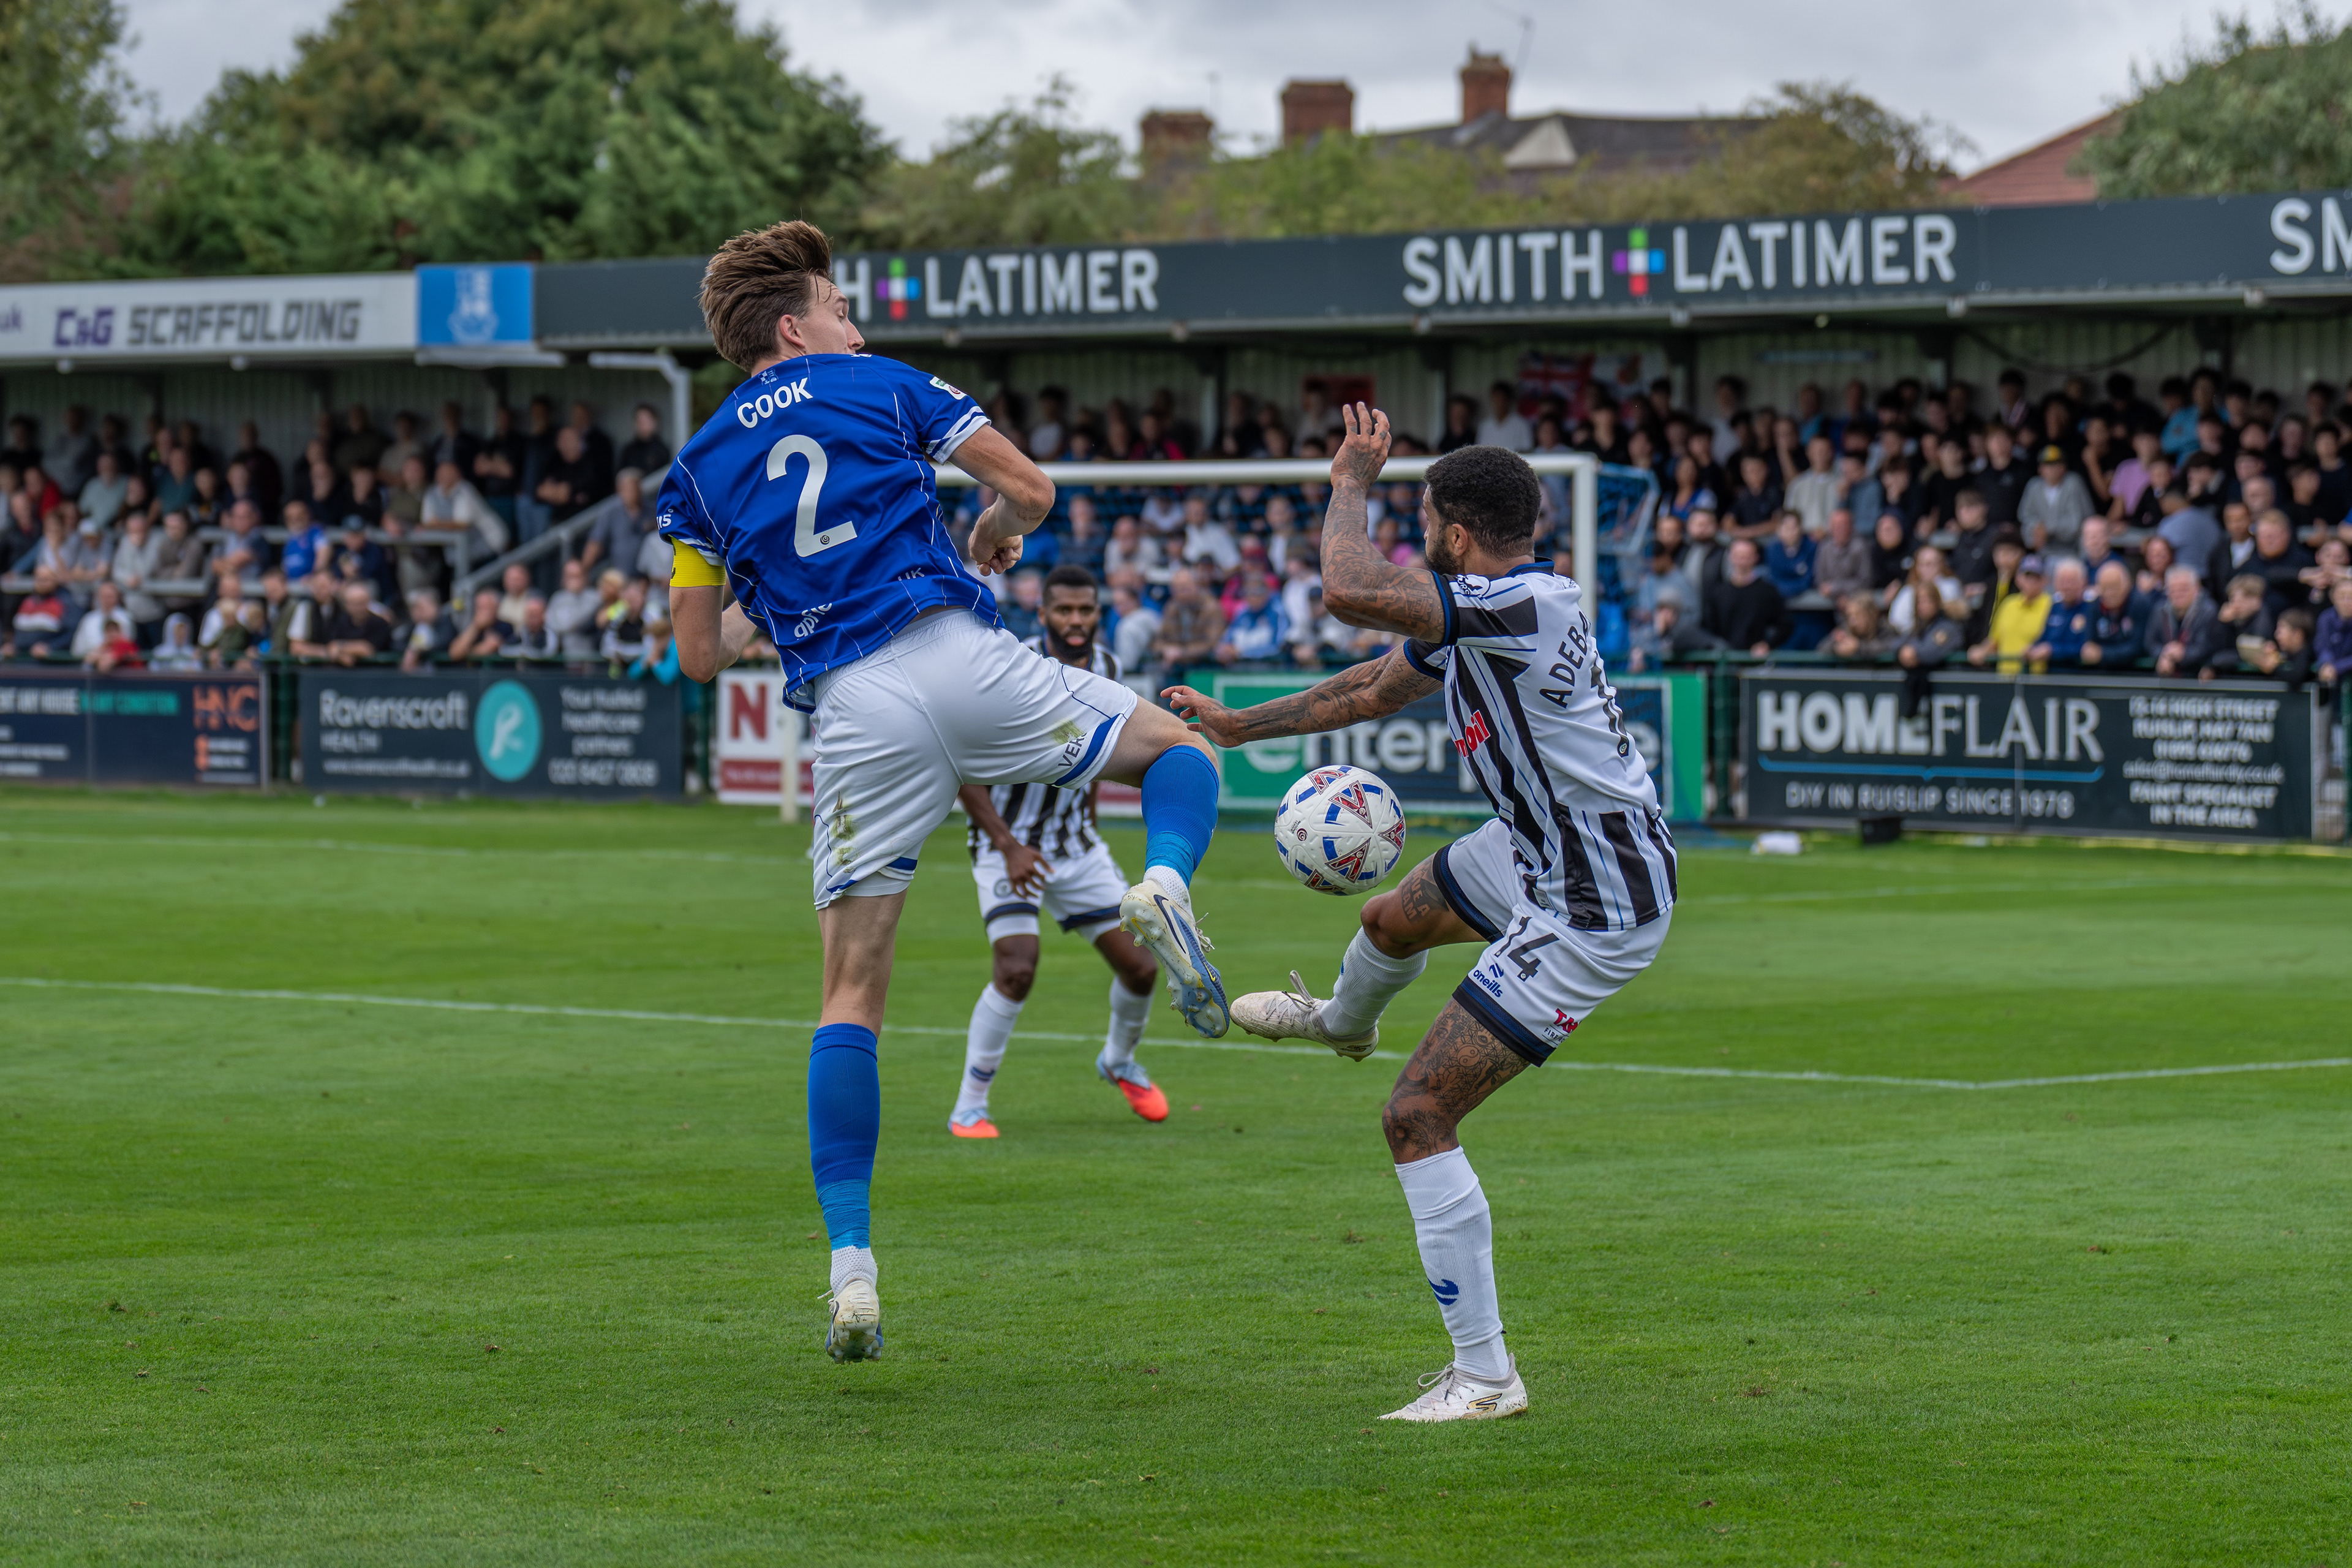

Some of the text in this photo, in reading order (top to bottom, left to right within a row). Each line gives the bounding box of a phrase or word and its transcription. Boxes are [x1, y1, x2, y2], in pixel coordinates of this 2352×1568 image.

[924, 249, 1160, 318] LATIMER
[1402, 214, 1957, 307] SMITH LATIMER
[127, 300, 362, 345] SCAFFOLDING
[737, 377, 813, 429] COOK
[766, 434, 858, 557] 2
[319, 688, 469, 730] Ravenscroft
[320, 729, 382, 753] HEALTH
[1785, 781, 1825, 810] DIY
[1828, 782, 1853, 811] IN
[1858, 783, 1942, 812] RUISLIP
[1946, 787, 2015, 816] SINCE
[1494, 916, 1560, 982] 14
